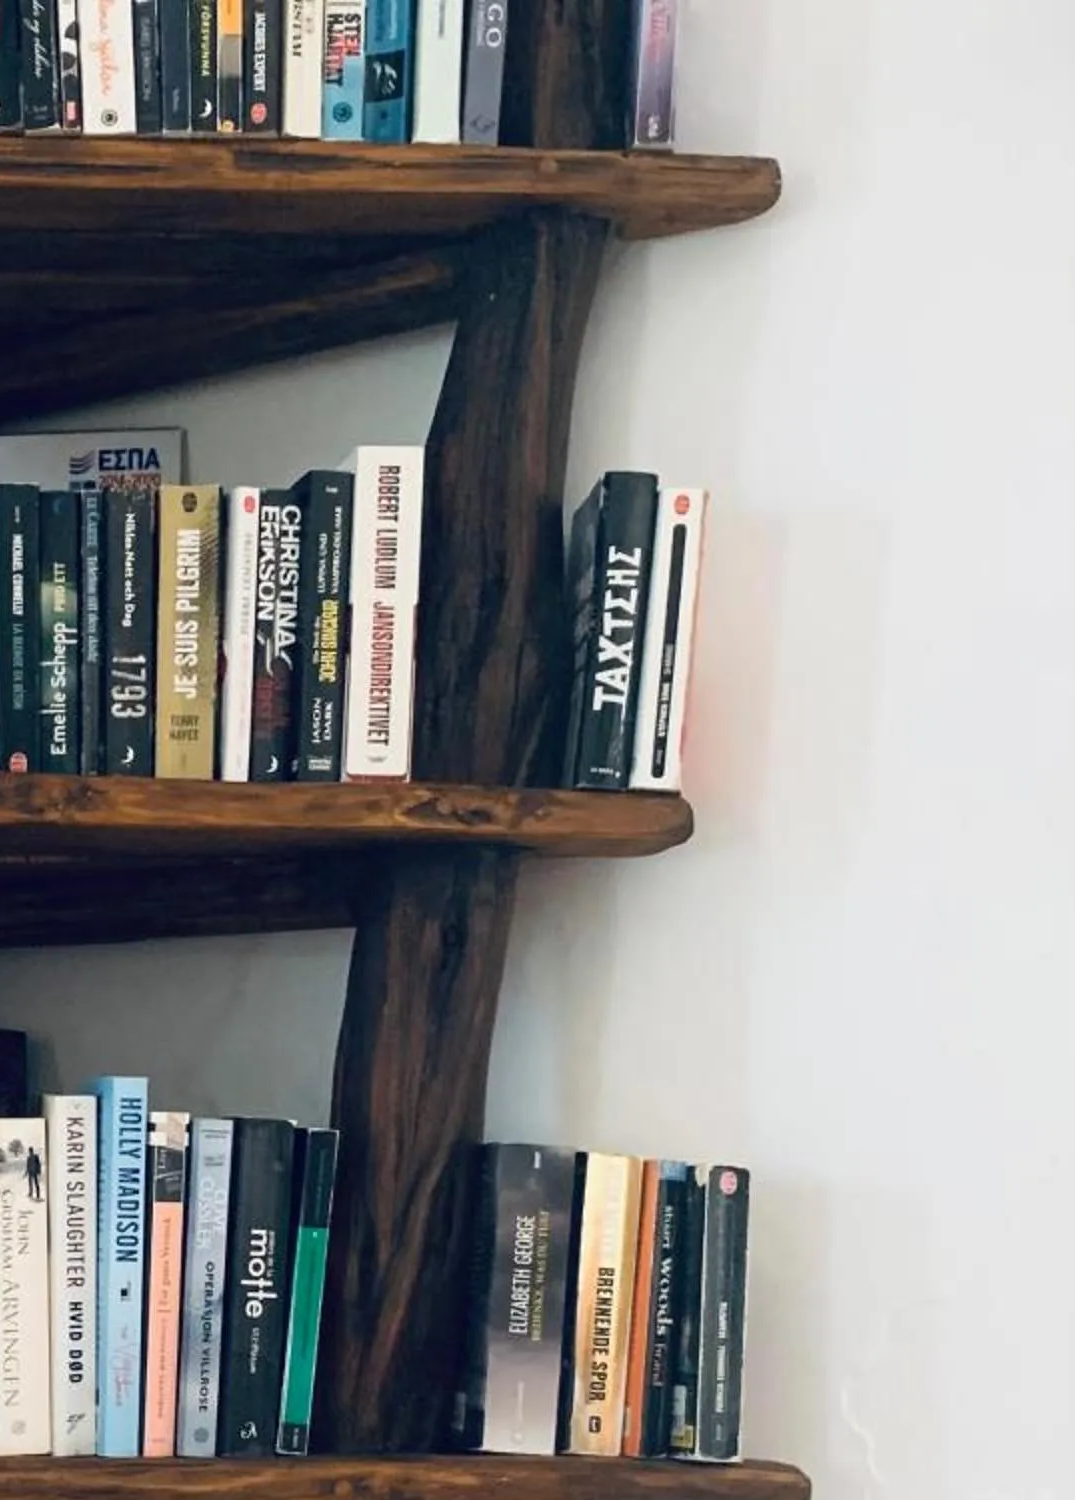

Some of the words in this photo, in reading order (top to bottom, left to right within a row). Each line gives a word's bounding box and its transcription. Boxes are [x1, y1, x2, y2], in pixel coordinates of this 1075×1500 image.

[99, 448, 161, 472] ΕΣΠΑ
[377, 464, 401, 522] ROBERT
[175, 529, 201, 612] PILGRIM
[257, 504, 281, 622] ERIKSON
[281, 503, 302, 652] CHRISTINA
[374, 525, 398, 590] LUDLUM
[38, 621, 78, 688] Schepp
[174, 619, 199, 671] SUIS
[592, 544, 643, 713] ΤΑΧΤΣΗΣ
[110, 655, 147, 718] 1793
[174, 674, 197, 699] JE
[366, 600, 396, 748] JANSONDIREKTIVET
[39, 692, 67, 756] Emelie
[311, 697, 322, 744] JASON
[322, 701, 333, 741] DARK
[66, 1116, 85, 1175] KARIN
[118, 1097, 143, 1161] HOLLY
[1, 1188, 15, 1271] GRISHAM
[16, 1209, 35, 1256] JOHN
[66, 1179, 86, 1288] SLAUGHTER
[115, 1166, 142, 1263] MADISON
[514, 1215, 536, 1264] GEORGE
[200, 1261, 216, 1346] OPERASJON
[240, 1228, 278, 1318] motte
[508, 1264, 531, 1335] ELIZABETH
[656, 1257, 674, 1337] woods
[2, 1278, 21, 1407] ARVINGEN
[69, 1301, 85, 1342] HVID
[592, 1267, 615, 1355] BRENNENDE
[68, 1347, 85, 1385] DØD
[198, 1348, 213, 1413] VILLROSE
[588, 1359, 608, 1402] SPOR
